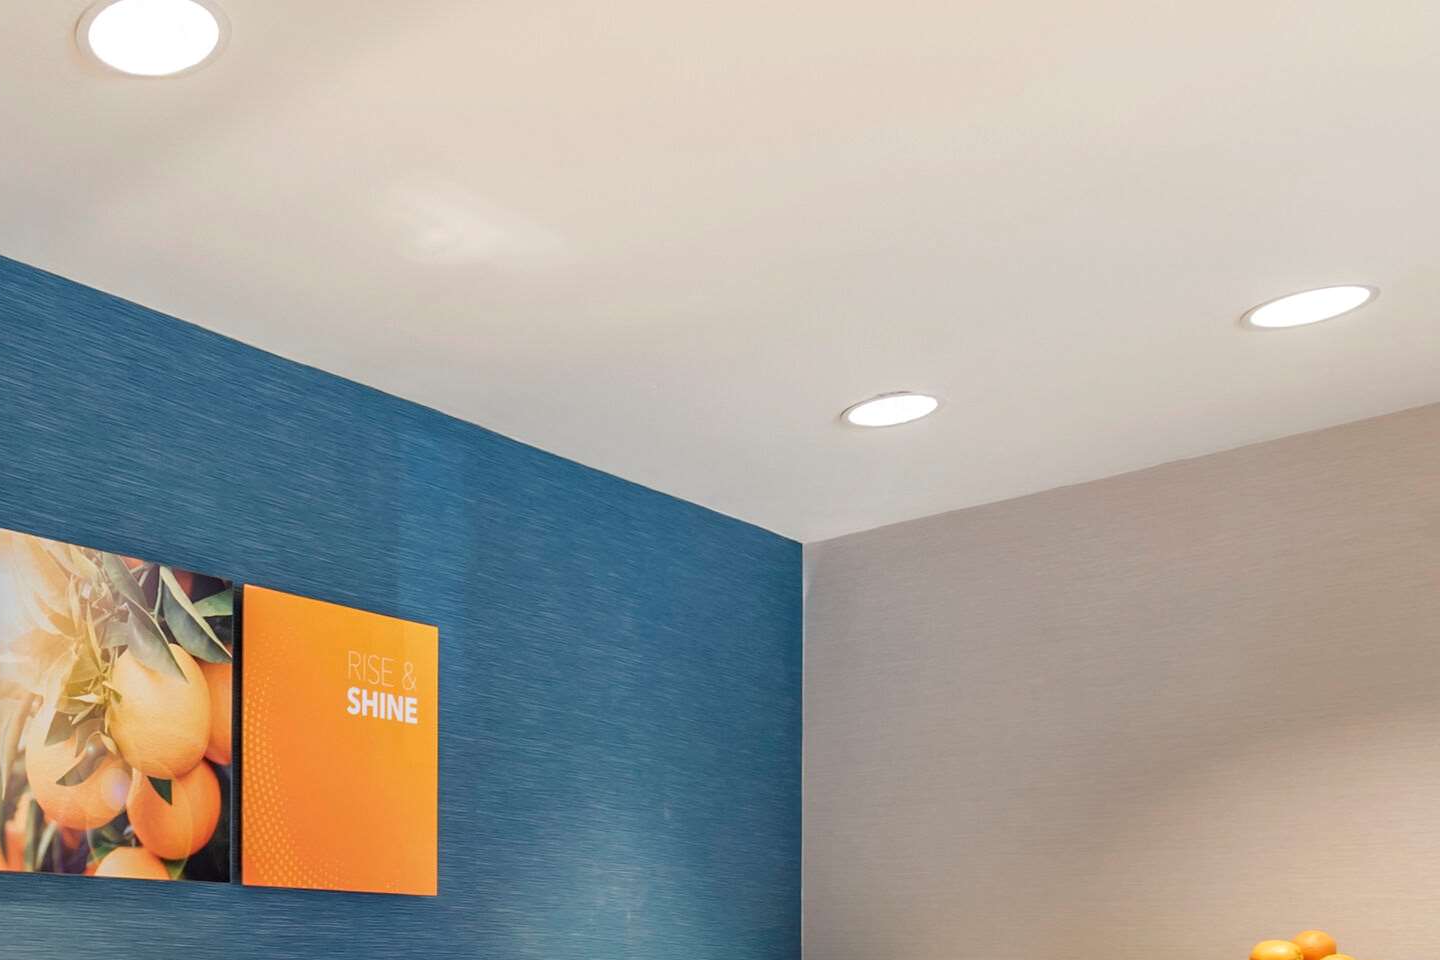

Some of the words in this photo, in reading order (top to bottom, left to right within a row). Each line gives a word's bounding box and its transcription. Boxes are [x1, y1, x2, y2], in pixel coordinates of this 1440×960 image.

[347, 650, 397, 688] RISE
[402, 661, 417, 690] &
[346, 686, 418, 725] SHINE
